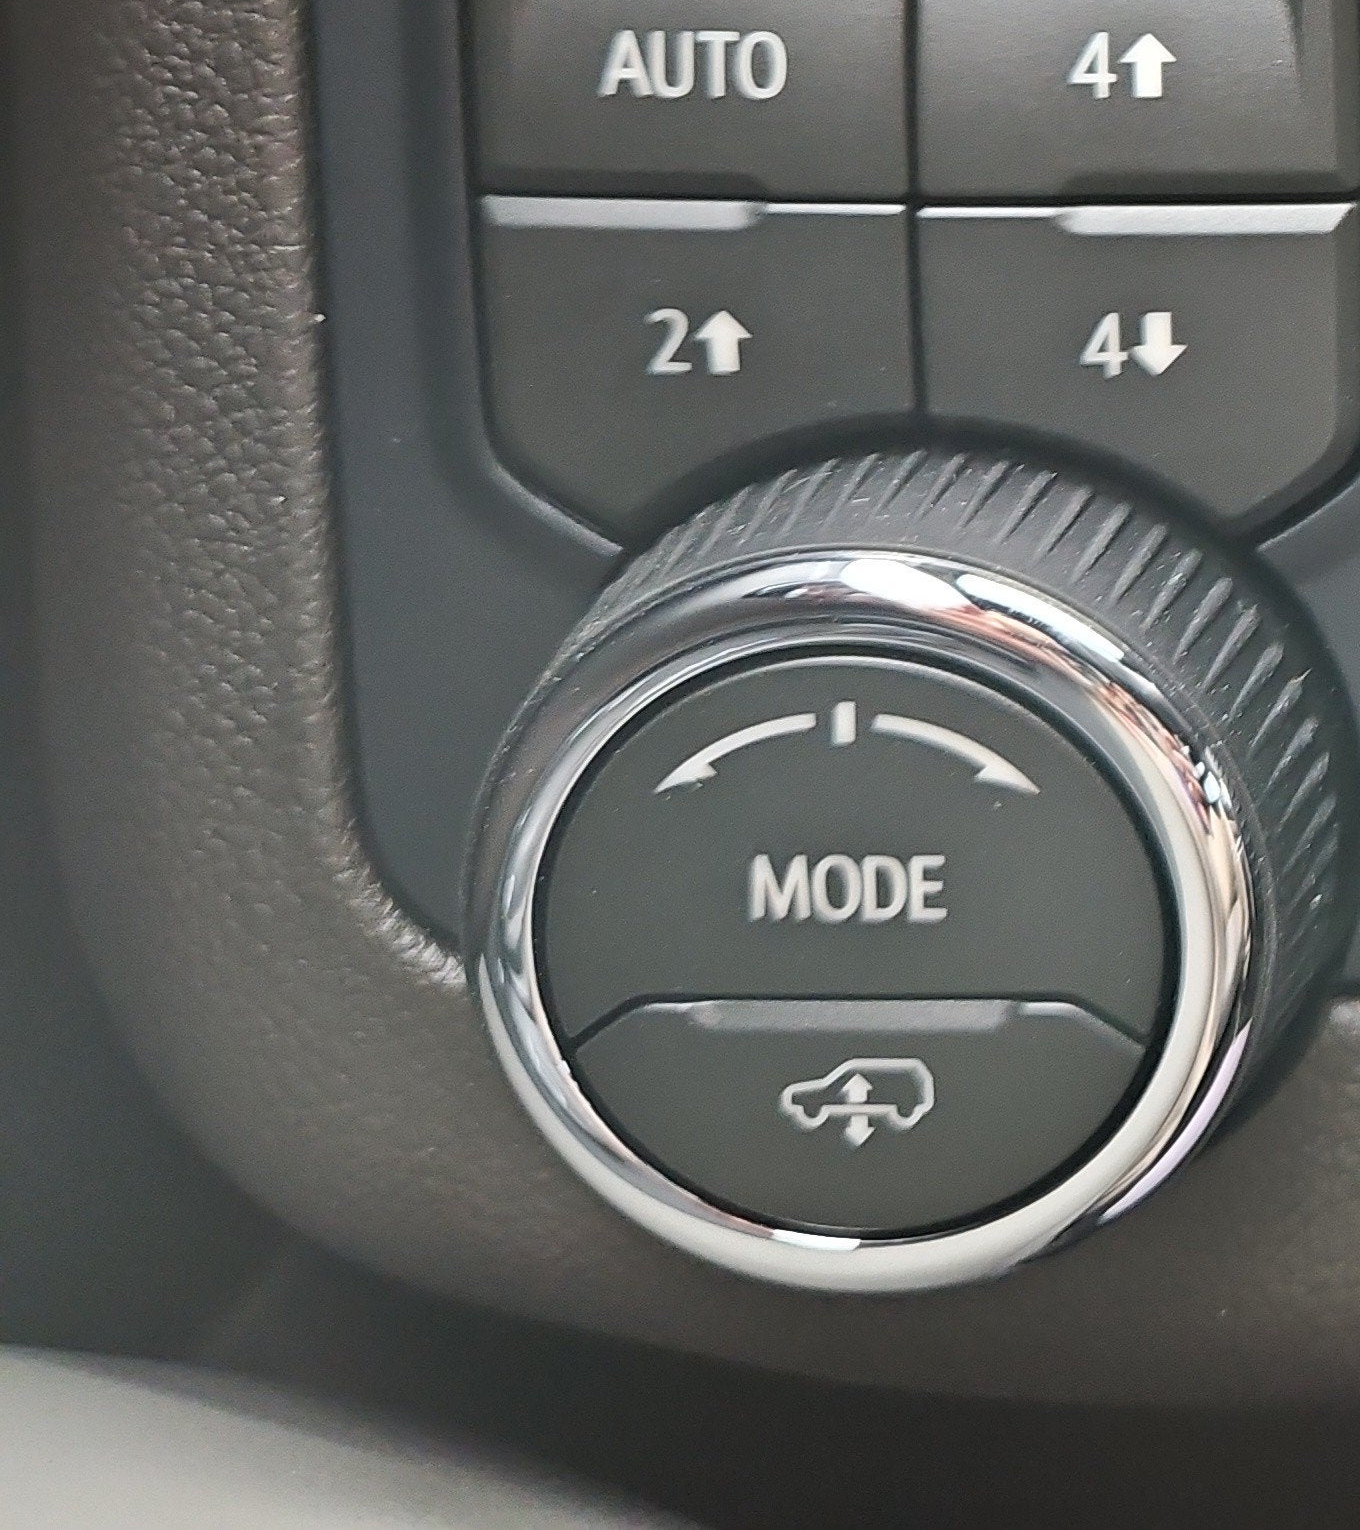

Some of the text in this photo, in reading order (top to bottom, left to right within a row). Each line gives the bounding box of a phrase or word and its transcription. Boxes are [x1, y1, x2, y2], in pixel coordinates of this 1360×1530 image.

[598, 29, 790, 100] AUTO
[1069, 31, 1118, 100] 4
[645, 308, 693, 376] 2
[1080, 311, 1130, 378] 4
[748, 854, 949, 924] MODE
